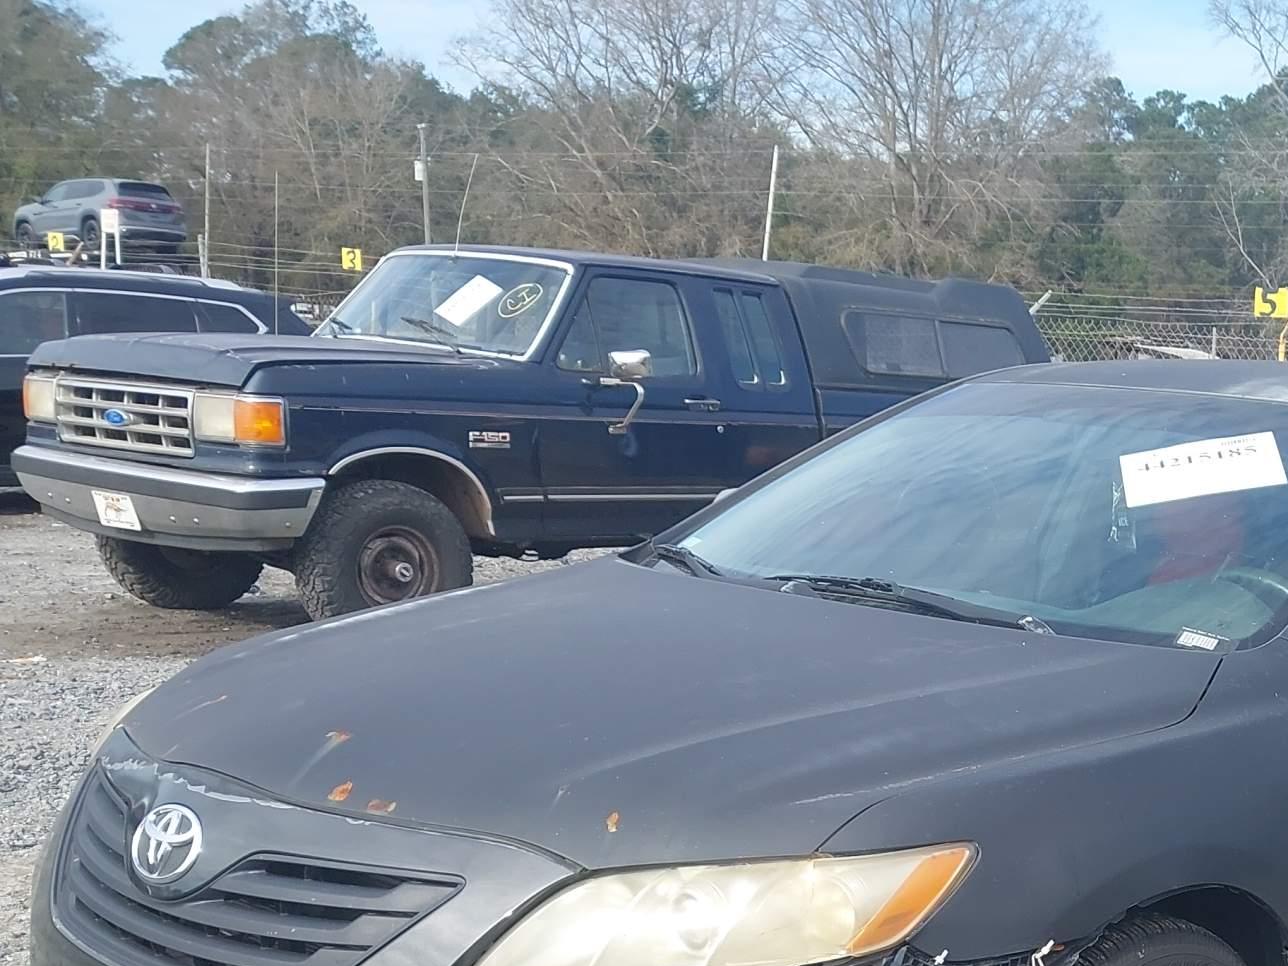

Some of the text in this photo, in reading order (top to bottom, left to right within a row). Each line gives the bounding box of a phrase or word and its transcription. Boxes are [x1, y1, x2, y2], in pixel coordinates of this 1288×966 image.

[346, 250, 356, 269] 3
[1260, 287, 1279, 317] 5
[468, 431, 511, 442] F-150
[1137, 445, 1258, 472] 44215185
